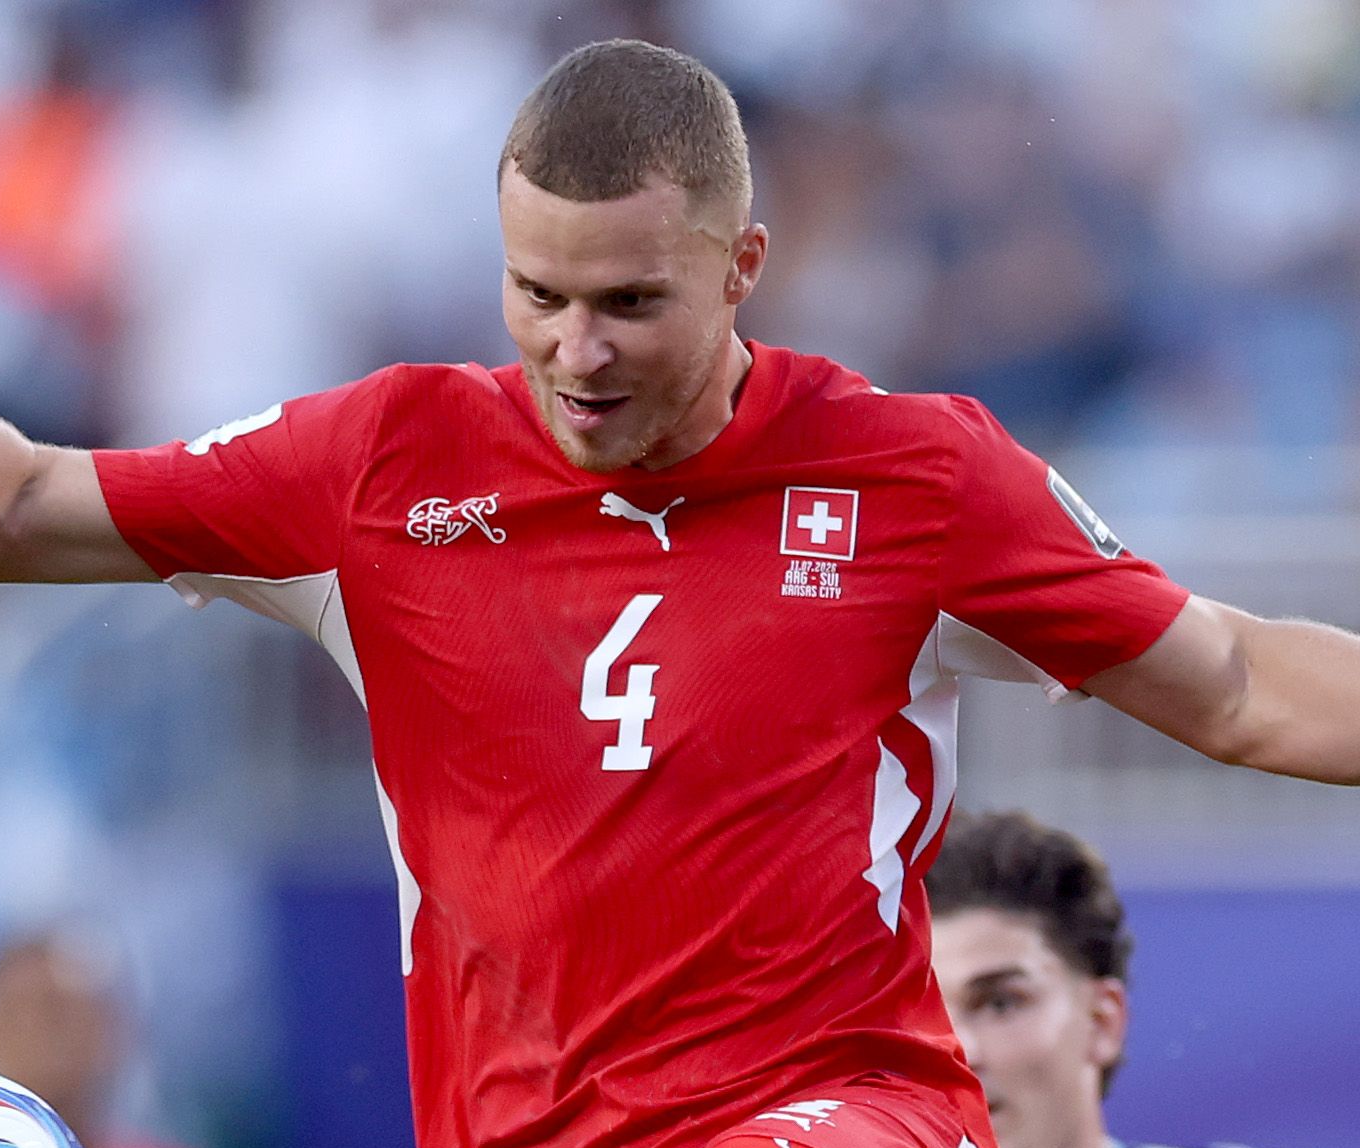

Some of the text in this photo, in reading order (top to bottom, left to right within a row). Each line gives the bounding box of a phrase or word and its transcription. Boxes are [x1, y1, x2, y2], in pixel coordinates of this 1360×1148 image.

[790, 560, 837, 573] 11.07.2026
[784, 570, 808, 585] ARG
[819, 572, 839, 587] SUI
[781, 584, 842, 599] KANSAS CITY
[580, 594, 664, 770] 4
